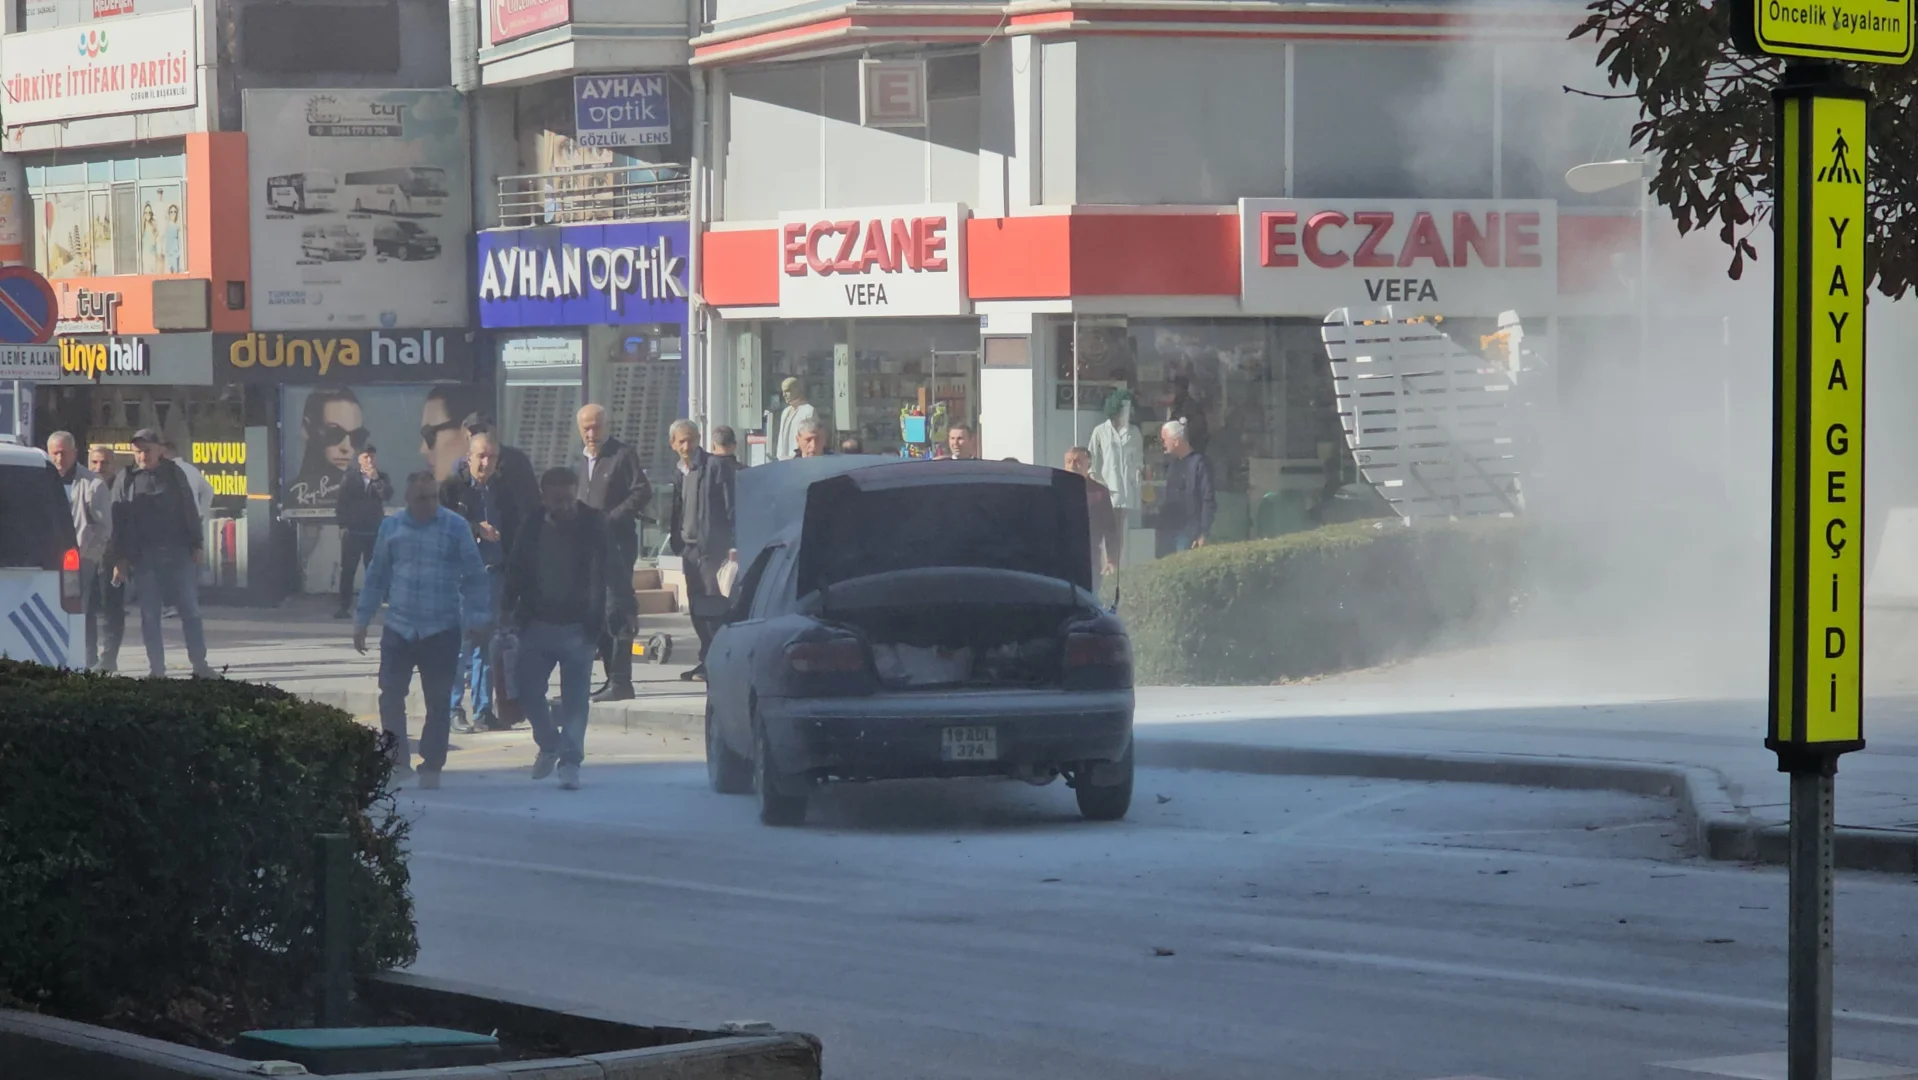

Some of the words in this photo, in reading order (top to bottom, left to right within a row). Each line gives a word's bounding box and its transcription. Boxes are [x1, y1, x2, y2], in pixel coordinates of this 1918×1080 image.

[1769, 0, 1826, 25] Öncelik
[1833, 6, 1900, 34] Yayaların
[8, 69, 61, 104] TÜRKİYE
[67, 63, 124, 96] İTTİFAKI
[131, 50, 187, 88] PARTİSİ
[131, 91, 148, 102] ÇORUM
[156, 85, 187, 99] BAŞKANLIĞI
[582, 78, 663, 99] AYHAN
[879, 74, 910, 112] E
[589, 98, 656, 129] optik
[580, 132, 626, 146] GÖZLÜK
[639, 132, 668, 144] LENS
[785, 216, 947, 276] ECZANE
[1260, 211, 1542, 268] ECZANE
[479, 246, 582, 300] AYHAN
[588, 236, 688, 310] optik
[1364, 279, 1438, 301] VEFA
[845, 284, 888, 306] VEFA
[1828, 217, 1849, 390] YAYA
[30, 351, 60, 366] ALANI
[110, 337, 143, 371] halı
[230, 333, 360, 375] dünya
[371, 331, 444, 364] halı
[1824, 423, 1848, 712] GEÇİDİ
